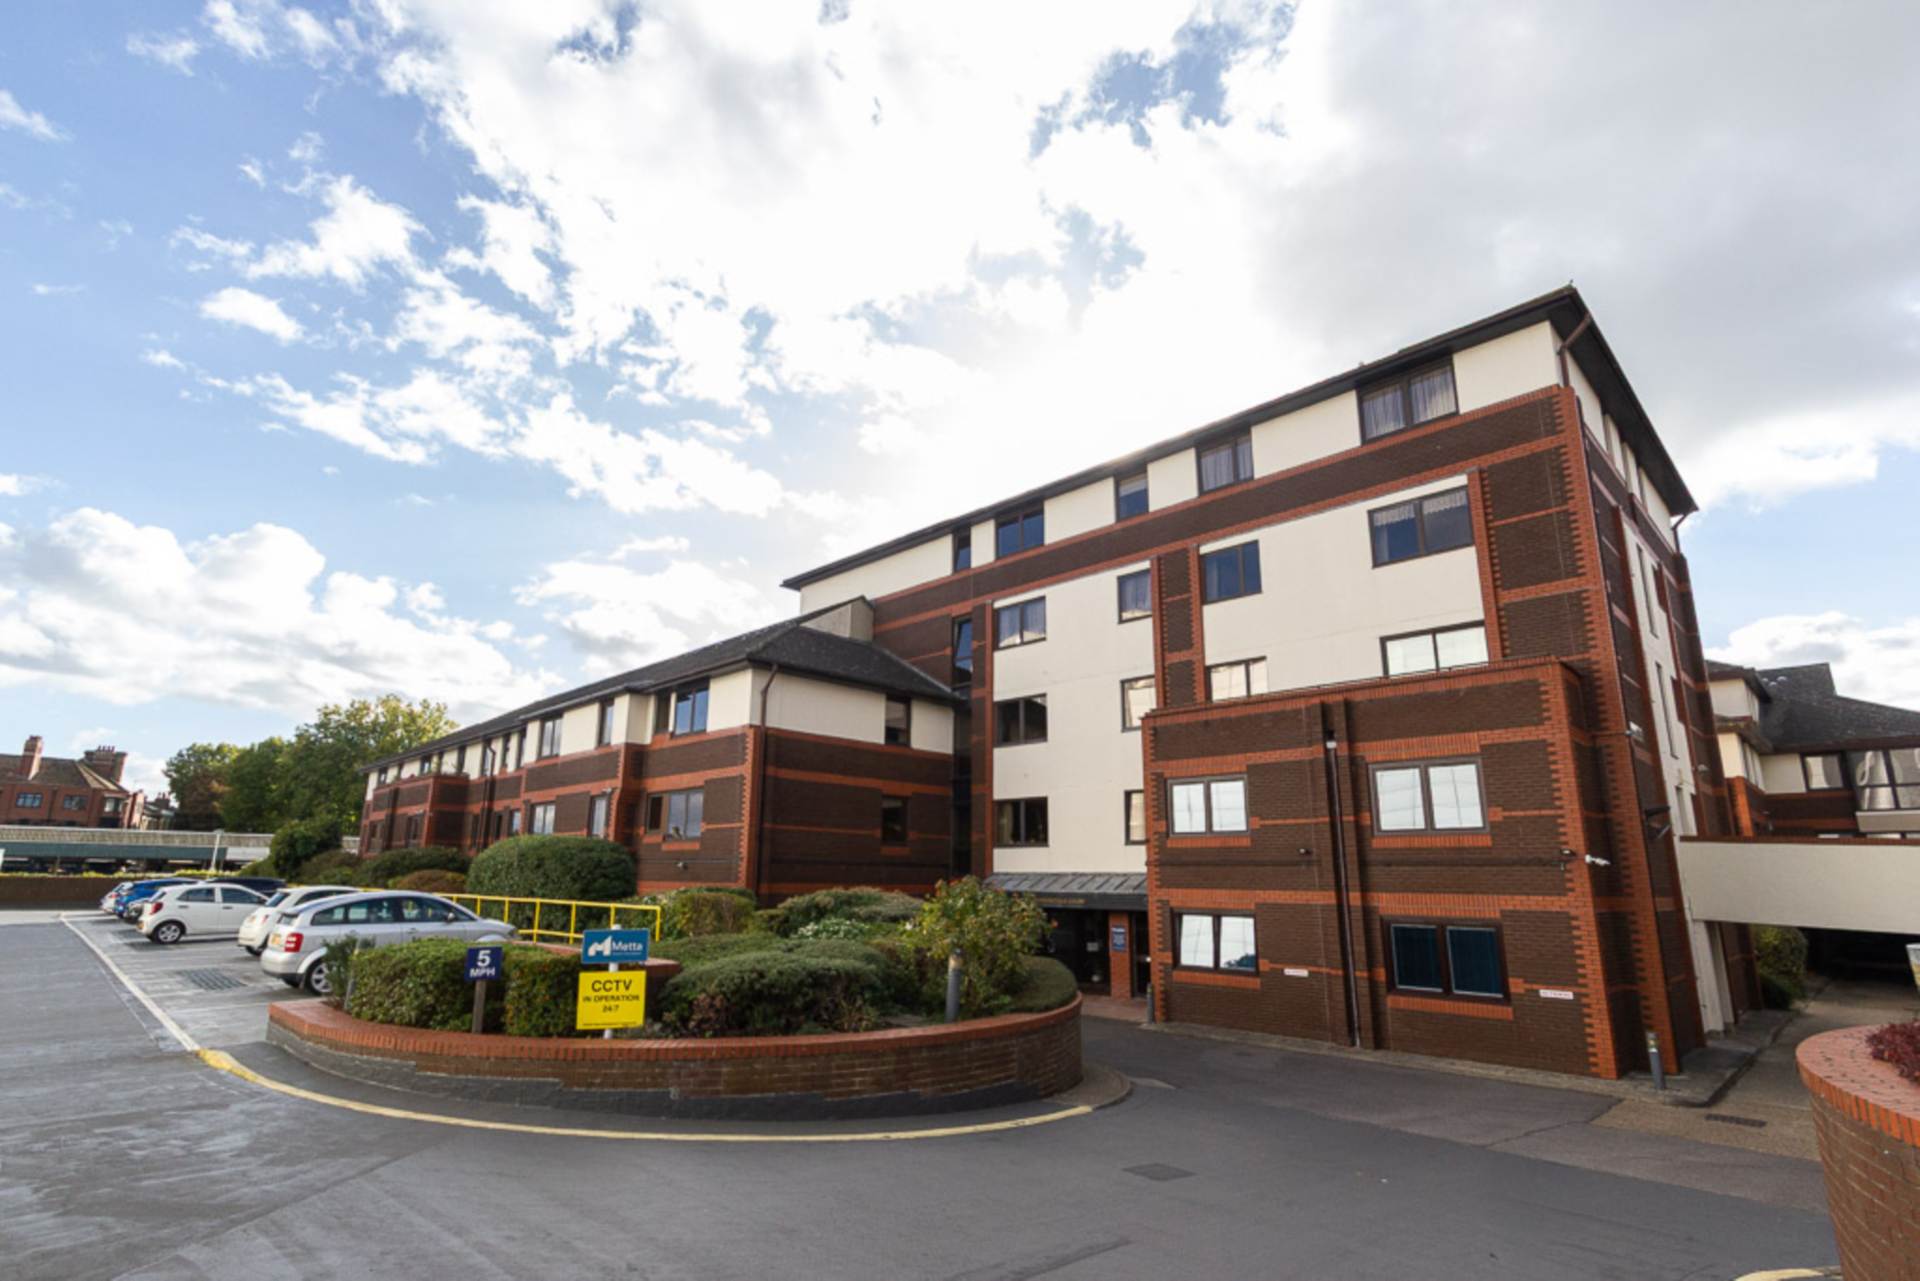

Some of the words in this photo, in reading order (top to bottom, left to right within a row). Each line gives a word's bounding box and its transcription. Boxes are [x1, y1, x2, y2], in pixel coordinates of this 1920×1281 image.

[612, 940, 643, 952] Metta
[477, 949, 491, 967] 5
[470, 967, 496, 978] MPH
[591, 979, 633, 993] CCTV
[582, 995, 592, 1003] IN
[594, 993, 640, 1003] OPERATION
